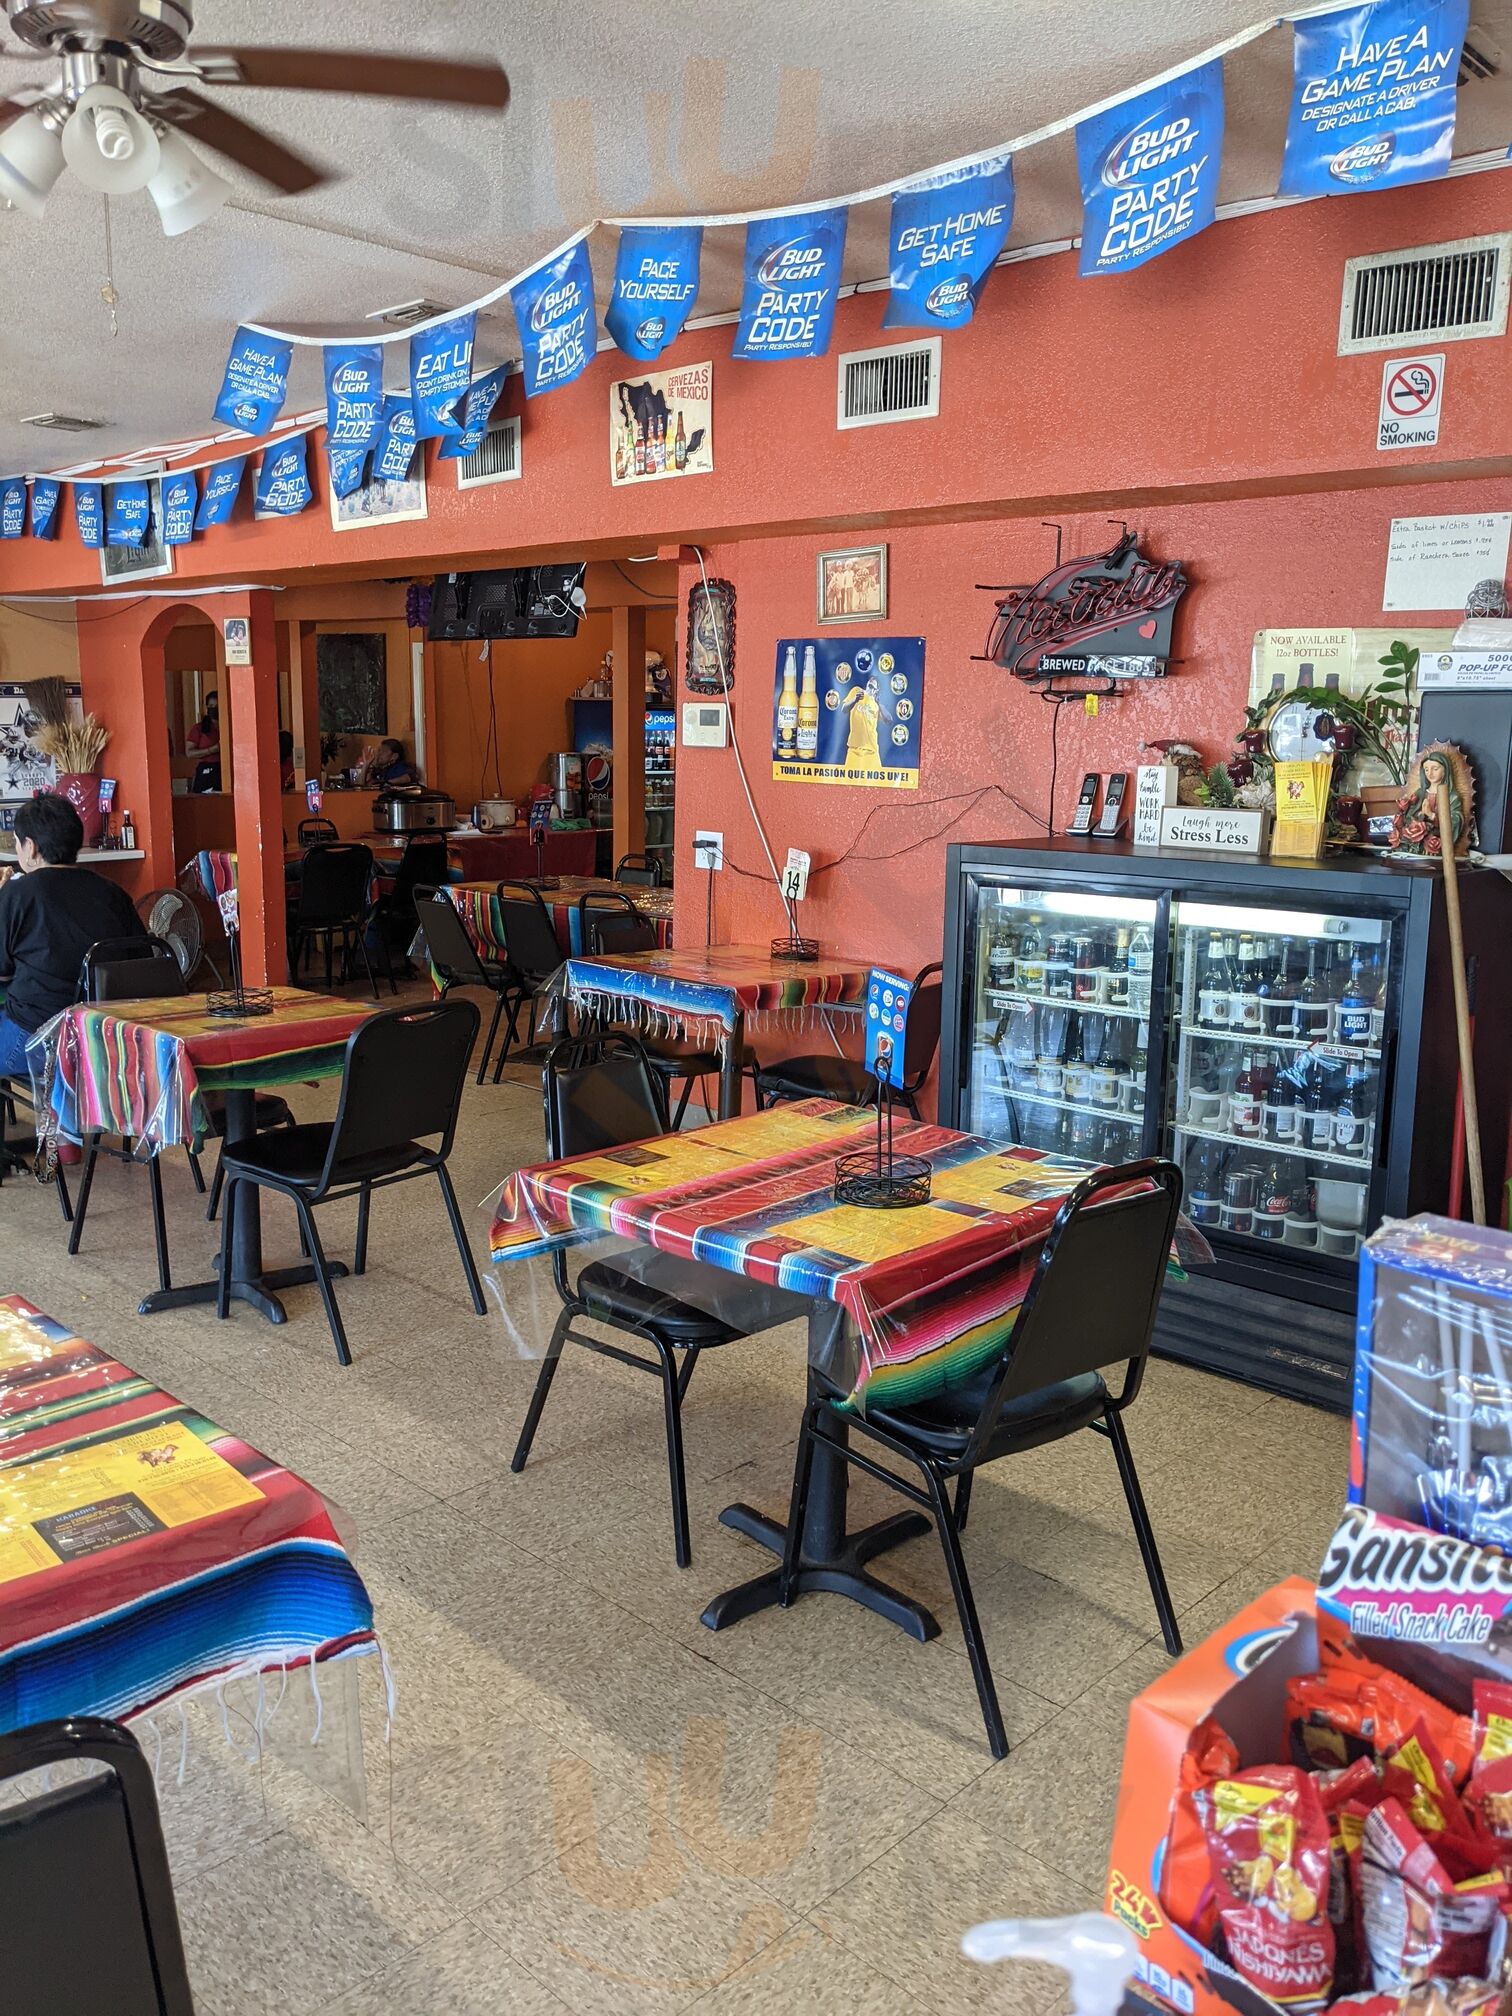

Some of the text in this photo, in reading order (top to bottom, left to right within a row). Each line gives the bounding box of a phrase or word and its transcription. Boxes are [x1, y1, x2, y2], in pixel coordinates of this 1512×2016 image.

[1337, 26, 1429, 73] HAVE A
[1300, 48, 1454, 104] GAME PLAN
[1301, 75, 1440, 121] DESIGNATE A DRIVER
[1316, 97, 1417, 132] OR CALL A CAB.
[1128, 117, 1190, 157] BUD
[1117, 130, 1199, 182] LIGHT
[1343, 150, 1392, 170] LIGHT
[1349, 142, 1389, 160] BUD
[1109, 155, 1207, 227] PARTY
[898, 204, 1006, 252] GET HOME
[1101, 188, 1199, 257] CODE
[1096, 219, 1192, 266] PARTY RESPONSIBLY
[780, 248, 823, 266] BUD
[920, 236, 976, 268] SAFE
[639, 258, 680, 278] PACE
[767, 262, 826, 282] LIGHT
[545, 282, 576, 311] BUD
[619, 280, 695, 301] YOURSELF
[938, 282, 968, 296] BUD
[757, 289, 830, 316] PARTY
[933, 290, 970, 308] LIGHT
[540, 290, 582, 327] LIGHT
[537, 308, 588, 359] PARTY
[748, 314, 820, 343] CODE
[536, 331, 585, 380] CODE
[744, 343, 768, 351] PARTY
[243, 348, 276, 368] HAVE A
[416, 351, 451, 379] EAT
[229, 358, 284, 386] GAME PLAN
[342, 369, 368, 381] BUD
[668, 368, 708, 387] CERVEZAS
[337, 381, 371, 393] LIGHT
[420, 377, 470, 398] EMPTY STOMAC
[667, 386, 708, 400] DE MEXICO
[238, 409, 258, 421] LIGHT
[242, 404, 257, 416] BUD
[337, 401, 376, 419] PARTY
[333, 419, 376, 439] CODE
[393, 424, 416, 436] LIGH
[1381, 422, 1399, 434] NO
[387, 439, 416, 455] PART
[1380, 431, 1435, 446] SMOKING
[282, 454, 298, 466] BUD
[278, 463, 299, 477] LIGHT
[269, 475, 306, 493] PARTY
[117, 500, 131, 509] GET
[265, 489, 306, 507] CODE
[3, 509, 22, 519] PARTY
[79, 515, 97, 527] PARTY
[126, 510, 141, 519] SAFE
[168, 510, 191, 521] PARTY
[3, 519, 21, 531] CODE
[166, 522, 191, 536] CODE
[1271, 635, 1346, 645] NOW AVAILABLE
[1293, 648, 1338, 657] BOTTLES!
[1043, 659, 1085, 670] BREWED
[1458, 664, 1500, 672] POP-UP
[799, 719, 816, 727] Corona
[780, 766, 800, 775] TOMA
[814, 767, 845, 777] PASIÓN
[848, 770, 864, 779] QUE
[867, 771, 885, 779] NOS
[1144, 768, 1159, 781] stay
[24, 778, 45, 786] 2020
[588, 792, 608, 802] pepsi
[1139, 798, 1160, 808] WORK
[1139, 809, 1160, 820] HARD
[1182, 815, 1241, 829] Laugh more
[1170, 826, 1249, 845] Stress Less
[788, 871, 800, 891] 14
[872, 970, 909, 991] NOW SERVING:
[1344, 1021, 1367, 1029] LIGHT
[1351, 1603, 1491, 1641] Filled Snack Cake
